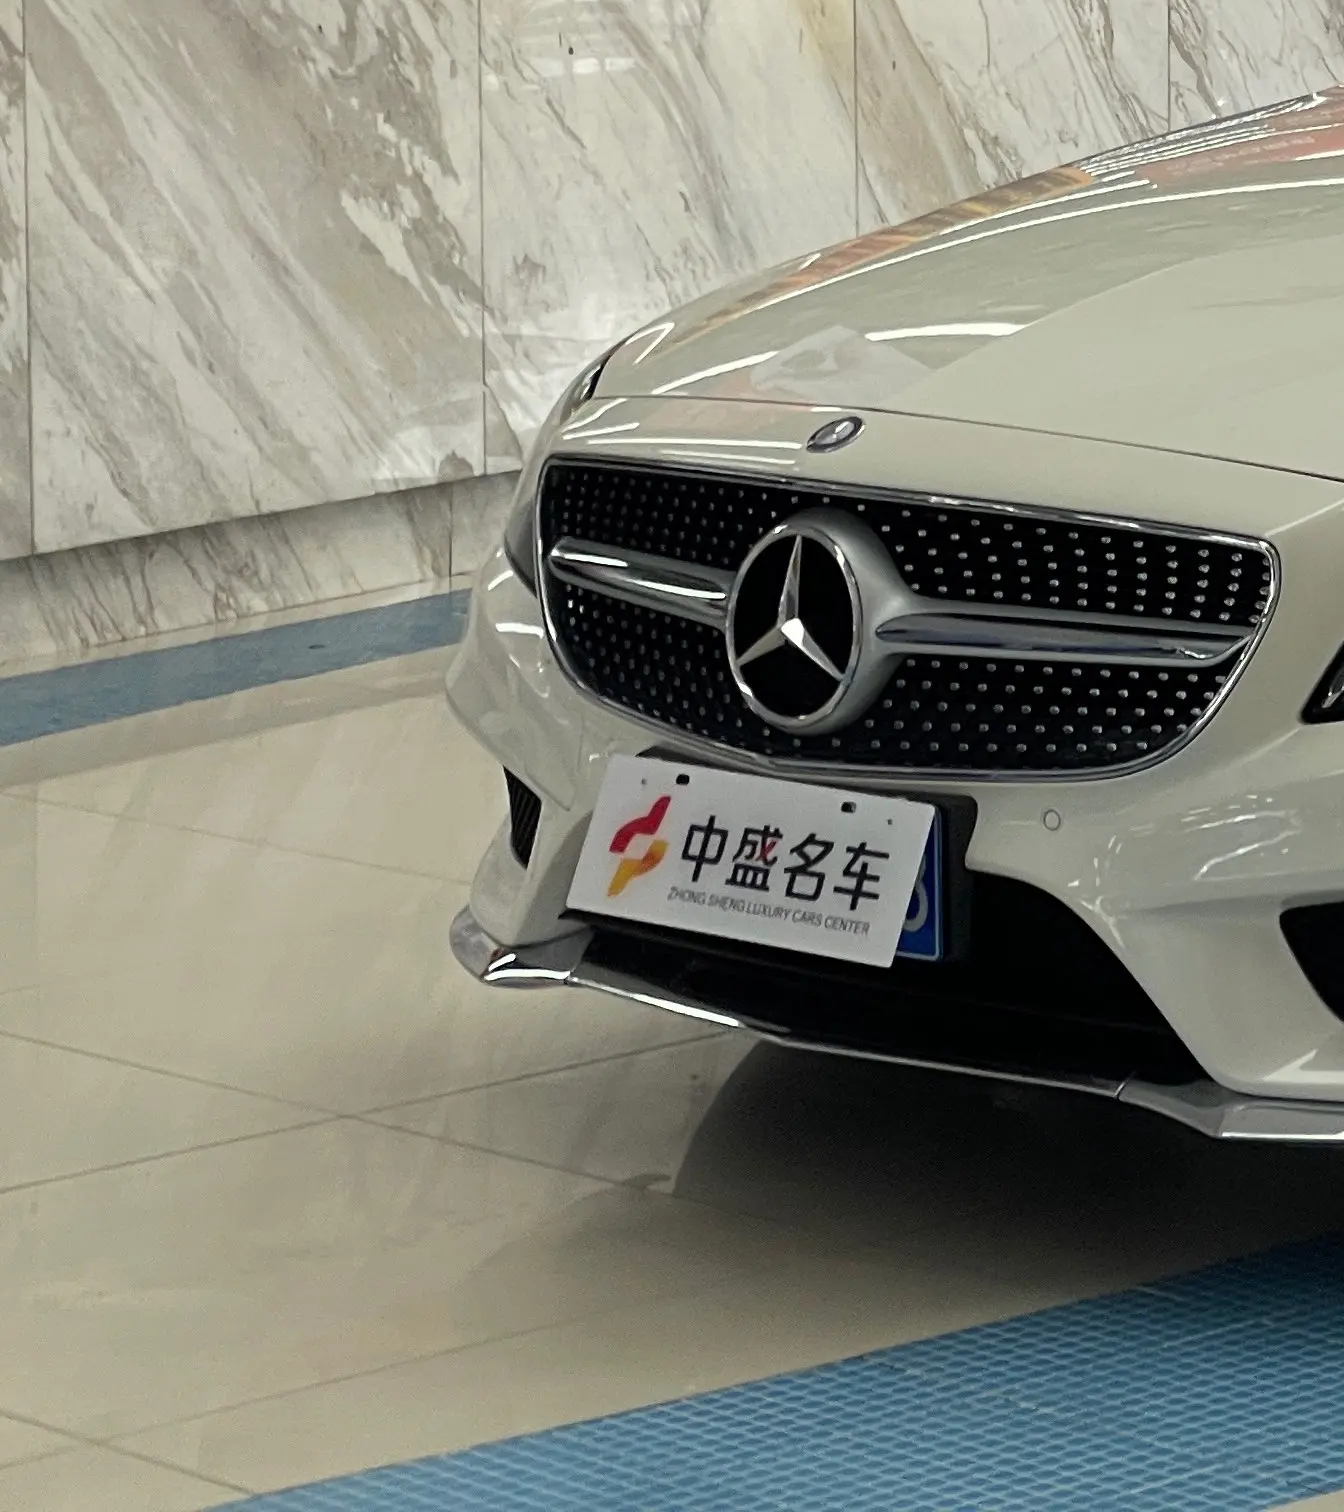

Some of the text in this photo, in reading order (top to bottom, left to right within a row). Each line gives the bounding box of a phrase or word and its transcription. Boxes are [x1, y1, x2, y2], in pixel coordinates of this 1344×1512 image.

[680, 814, 890, 912] 中盛名车
[666, 885, 870, 936] ZHONG SHENG LUXURY CARS CENTER
